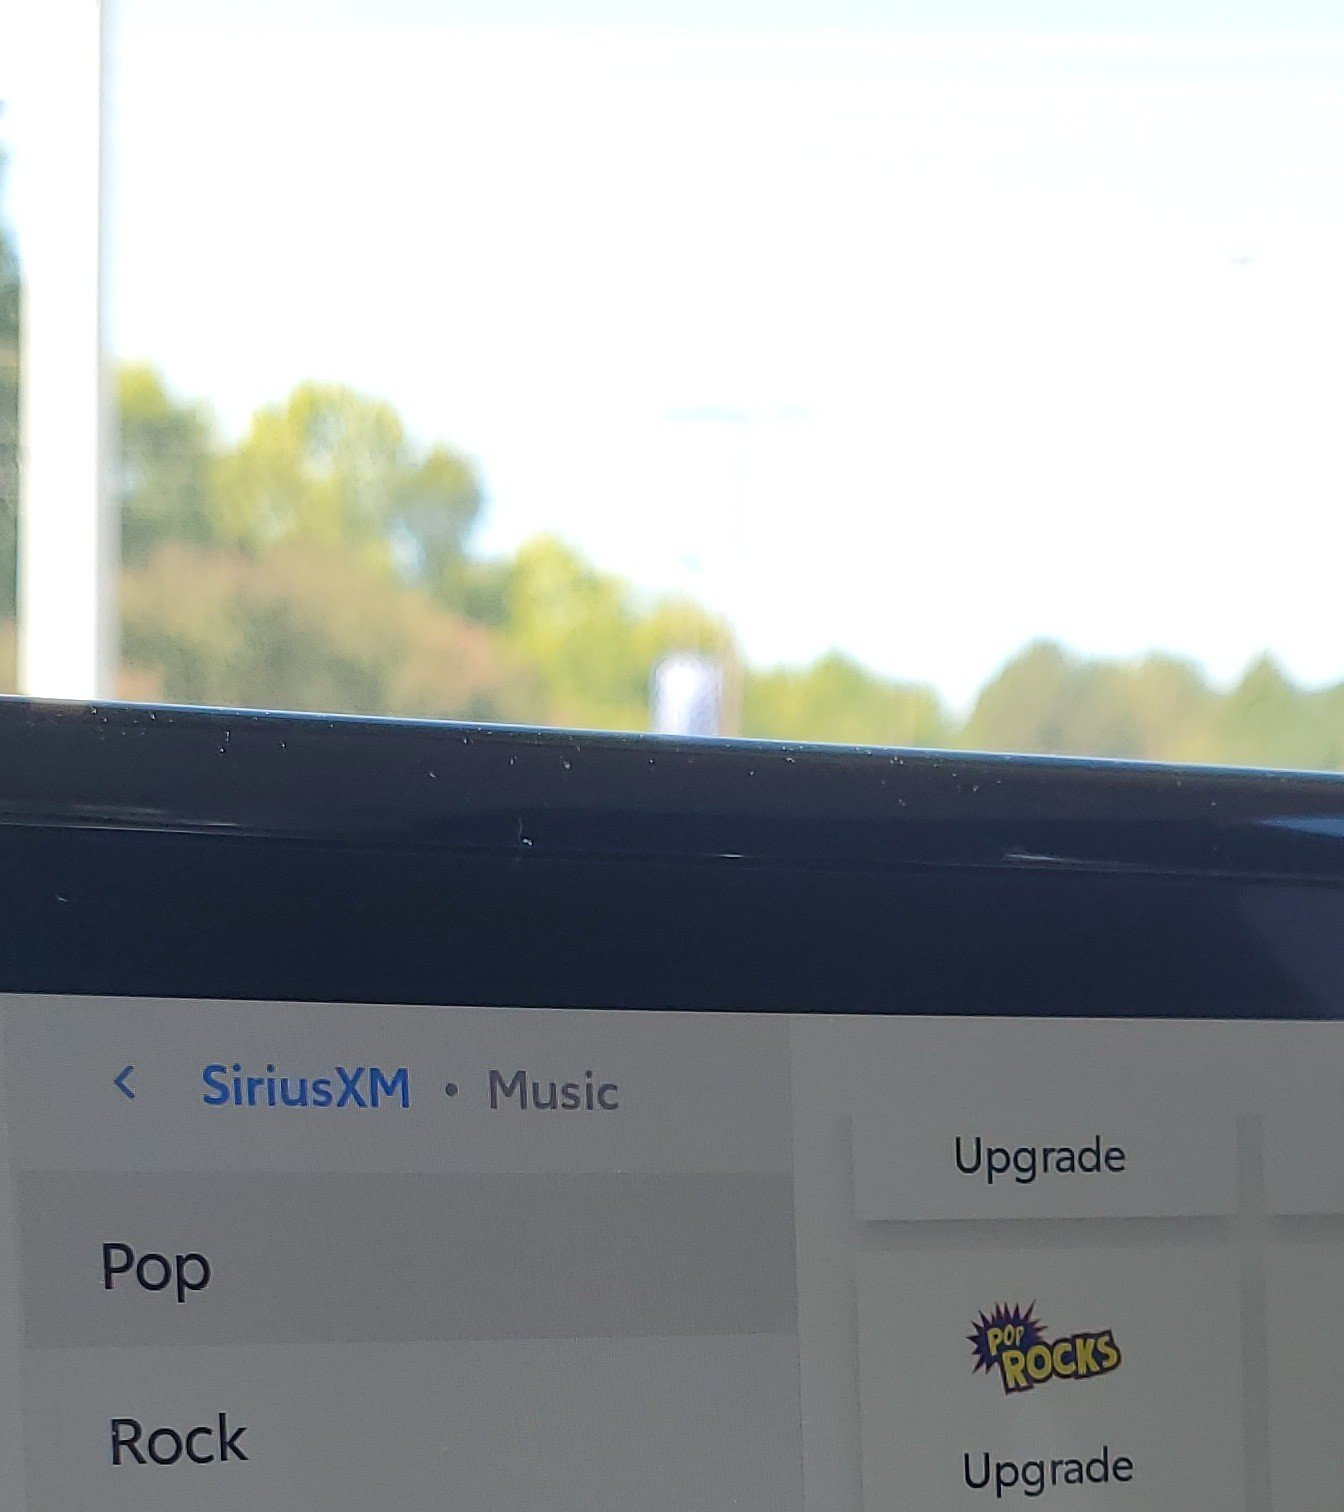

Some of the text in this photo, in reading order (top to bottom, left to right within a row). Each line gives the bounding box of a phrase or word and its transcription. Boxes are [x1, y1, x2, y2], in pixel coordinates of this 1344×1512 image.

[201, 1062, 620, 1112] SiriusXM Music
[954, 1134, 1127, 1184] Upgrade
[101, 1241, 212, 1305] Pop
[986, 1323, 1025, 1356] POP
[1001, 1335, 1119, 1390] ROCKS
[109, 1411, 250, 1467] Rock
[962, 1445, 1135, 1499] Upgrade
